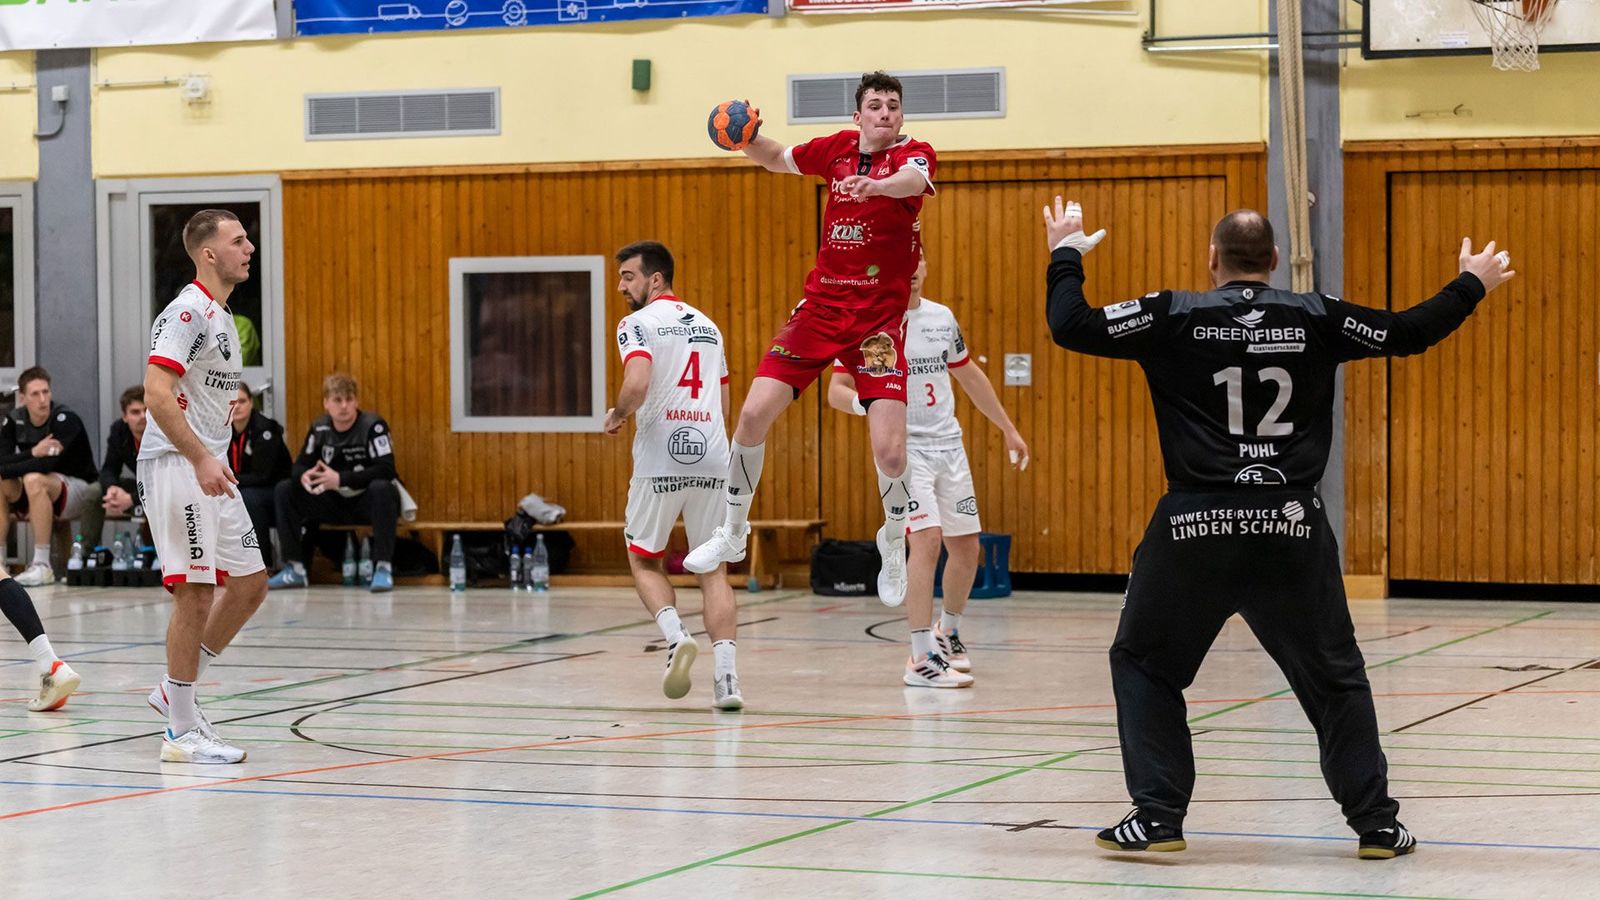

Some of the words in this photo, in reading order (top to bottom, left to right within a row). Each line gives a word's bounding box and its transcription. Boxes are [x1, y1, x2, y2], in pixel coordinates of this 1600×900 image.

[831, 225, 864, 240] KDE
[1107, 312, 1154, 335] BUCOLIN
[1193, 326, 1306, 342] GREENFIBER
[1343, 316, 1387, 342] pmd
[677, 351, 703, 400] 4
[925, 383, 937, 408] 3
[1212, 366, 1294, 437] 12
[666, 409, 712, 423] KARAULA
[672, 431, 703, 456] ifm
[1239, 443, 1279, 458] PUHL
[184, 503, 198, 545] KRÖNA
[1170, 509, 1279, 526] UMWELTSERVICE
